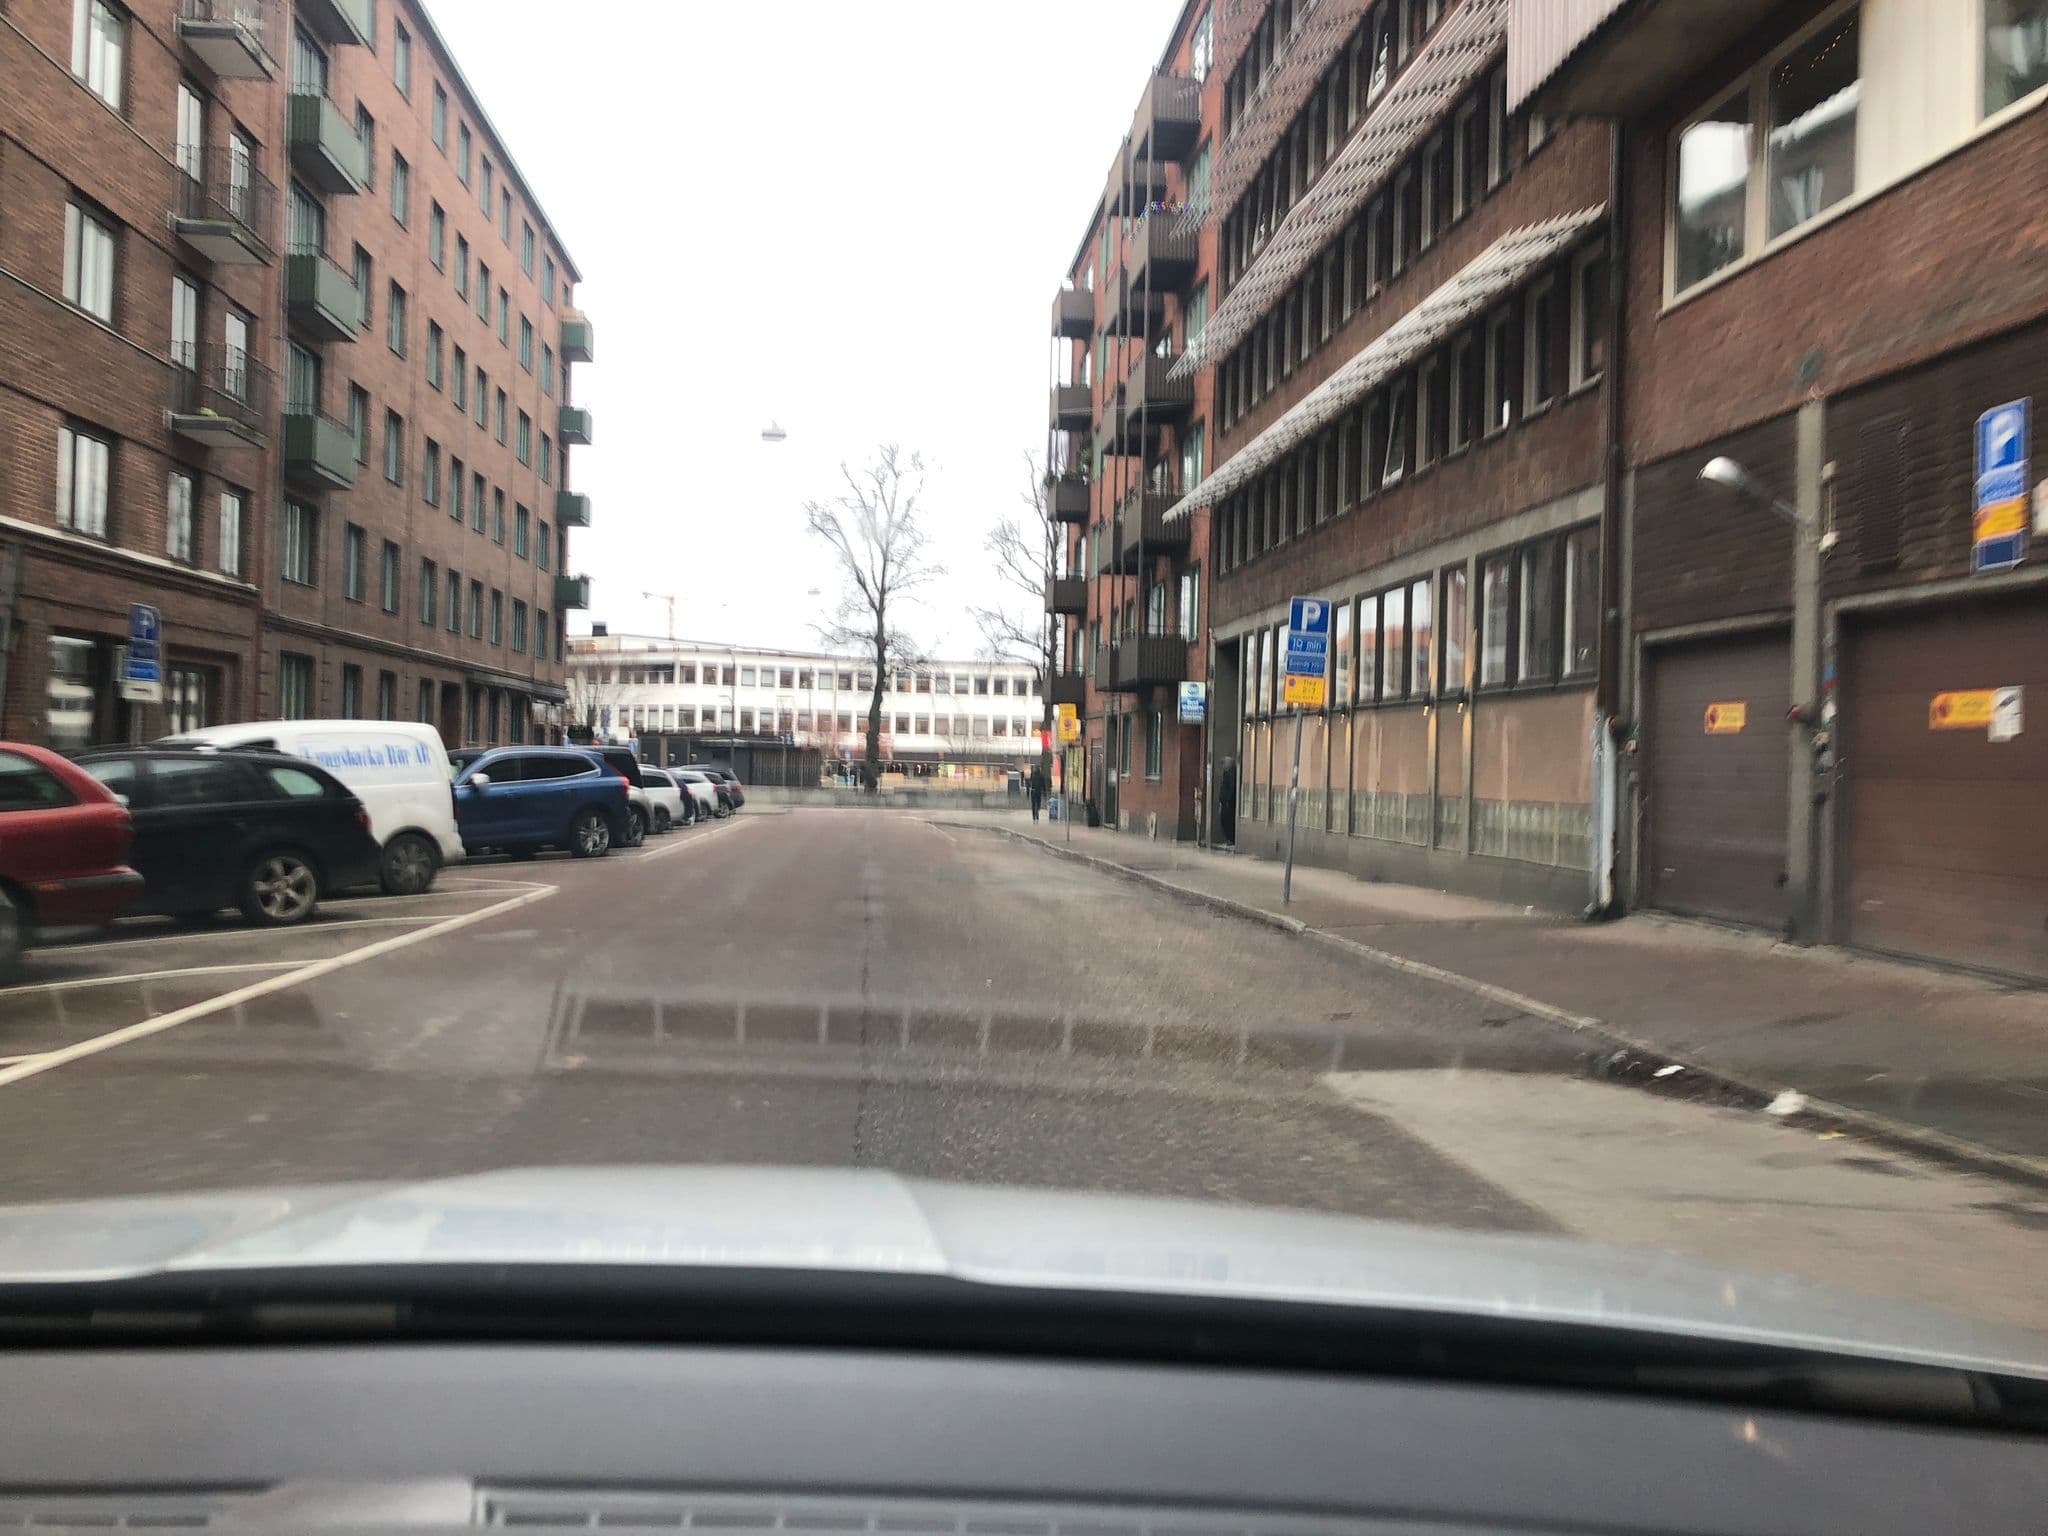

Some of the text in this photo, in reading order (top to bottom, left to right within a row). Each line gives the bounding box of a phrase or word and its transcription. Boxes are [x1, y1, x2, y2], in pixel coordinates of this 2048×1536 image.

[1301, 600, 1321, 632] P
[1293, 638, 1322, 650] 10 min
